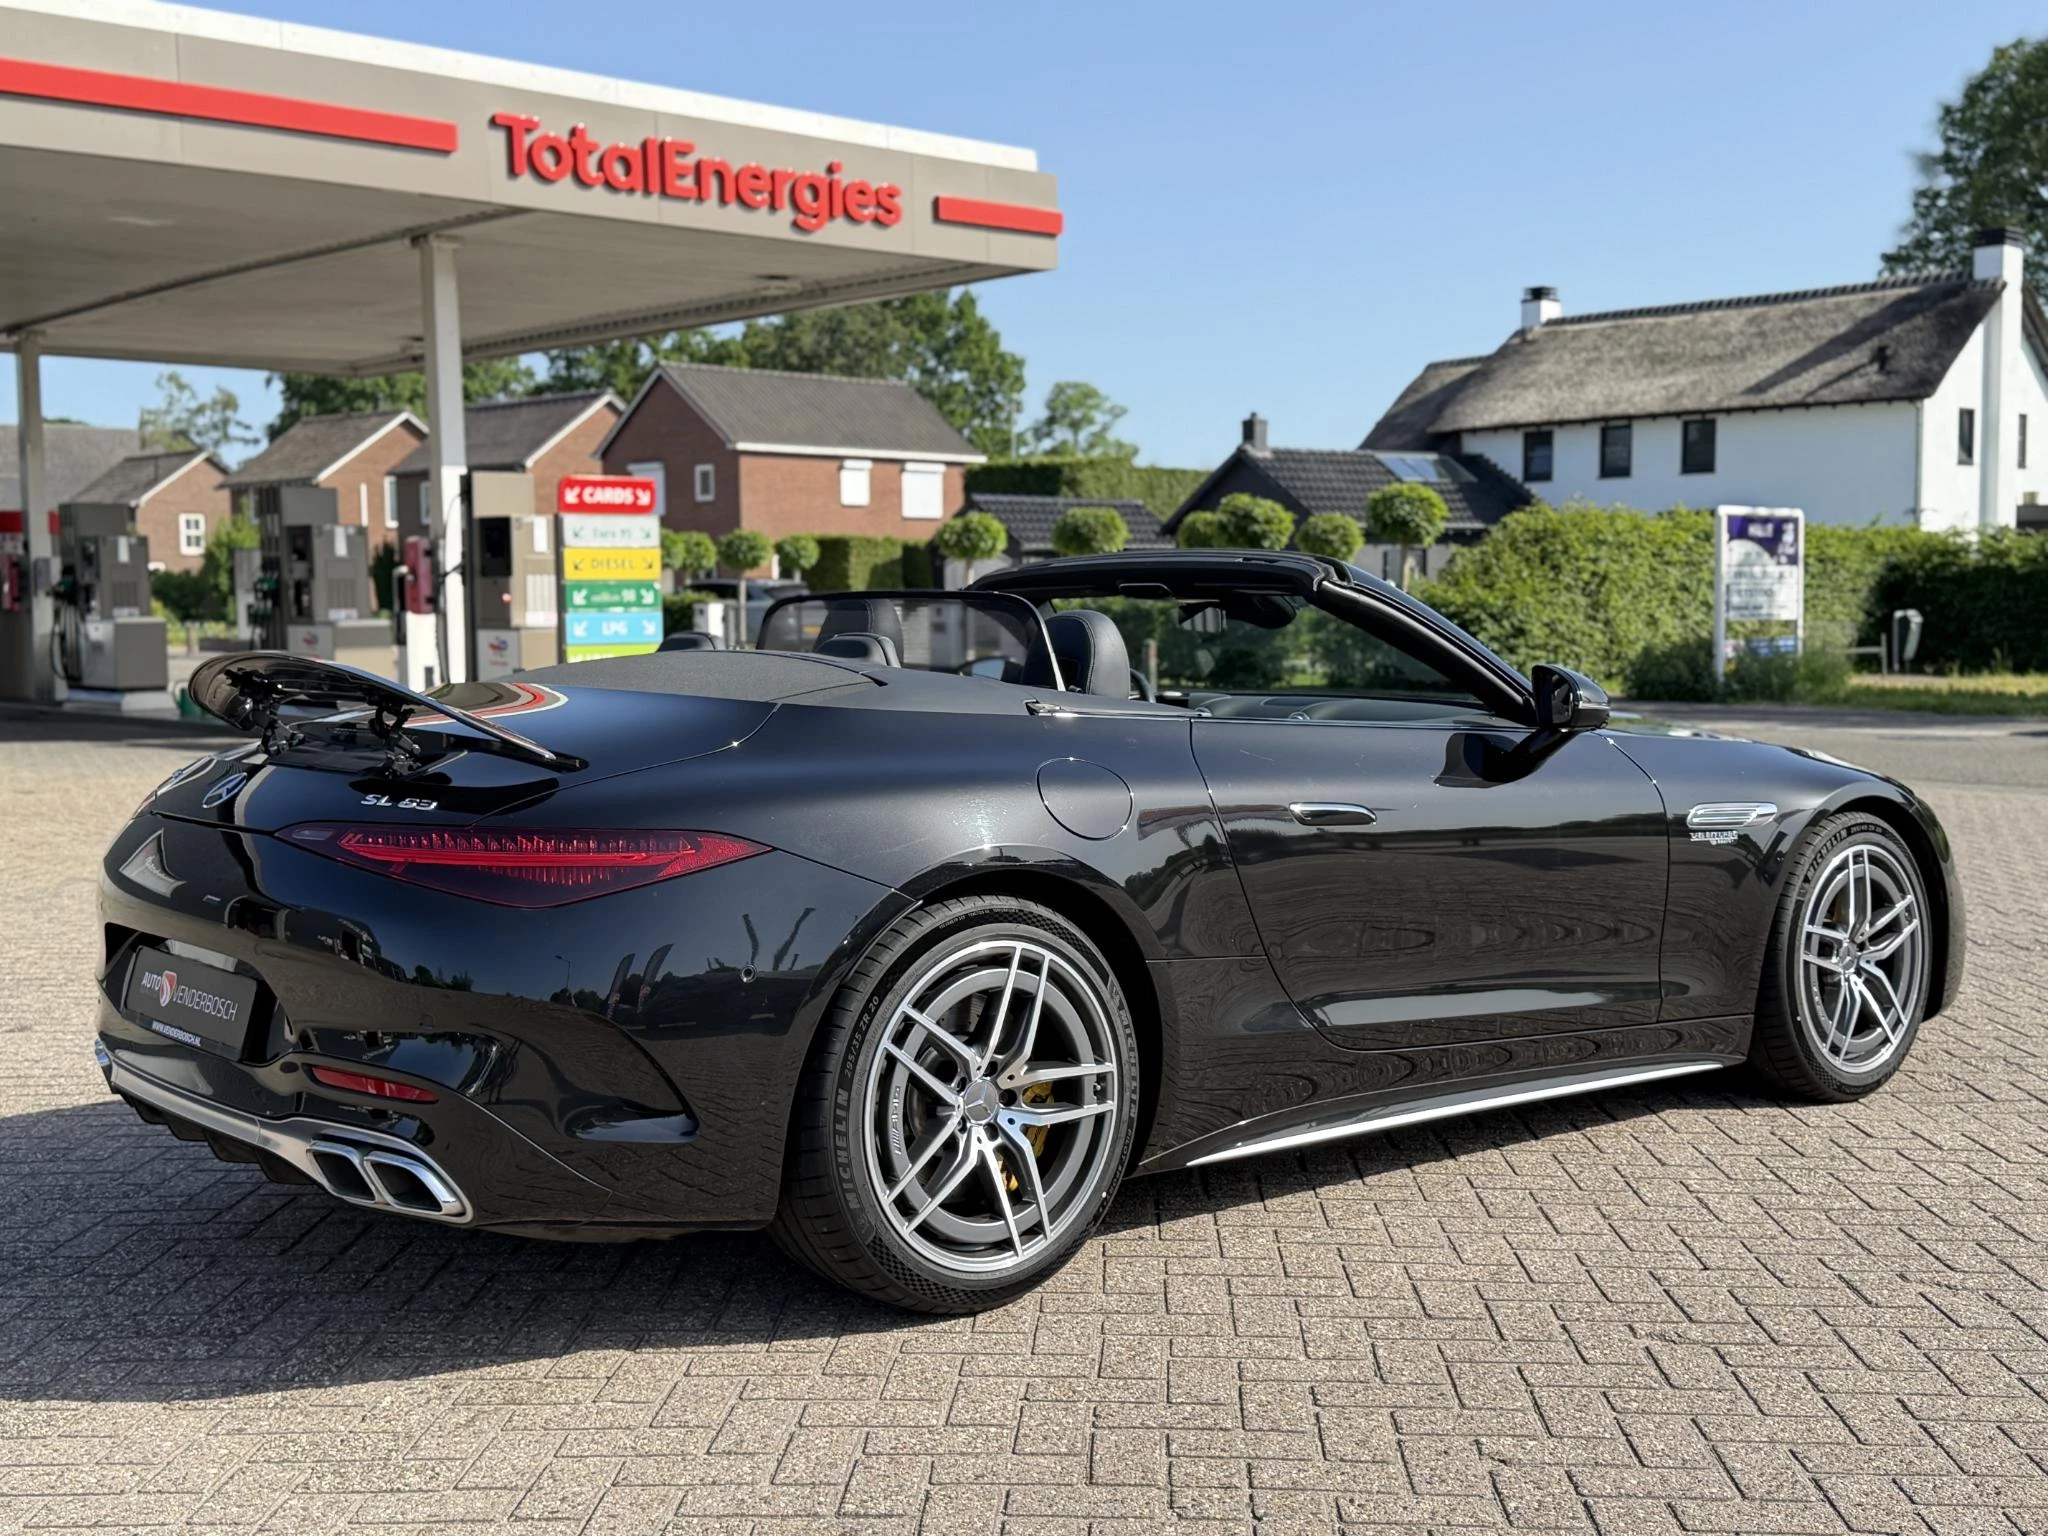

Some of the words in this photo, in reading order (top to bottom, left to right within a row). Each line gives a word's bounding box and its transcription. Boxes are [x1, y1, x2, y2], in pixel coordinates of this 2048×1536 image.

[490, 111, 903, 233] TotalEnergies
[582, 485, 636, 505] CARDS
[591, 558, 635, 571] DIESEL
[601, 621, 629, 636] LPG
[360, 793, 393, 807] SL
[397, 797, 439, 811] 63
[1806, 828, 1848, 881] MICHELIN
[141, 971, 162, 991] AUTO
[172, 984, 239, 1022] VENDERBOSCH
[844, 1031, 862, 1079] 295/35
[860, 1013, 872, 1032] ZR
[868, 995, 880, 1013] 20
[1119, 1008, 1138, 1119] MICHELIN
[835, 1087, 861, 1209] MICHELIN
